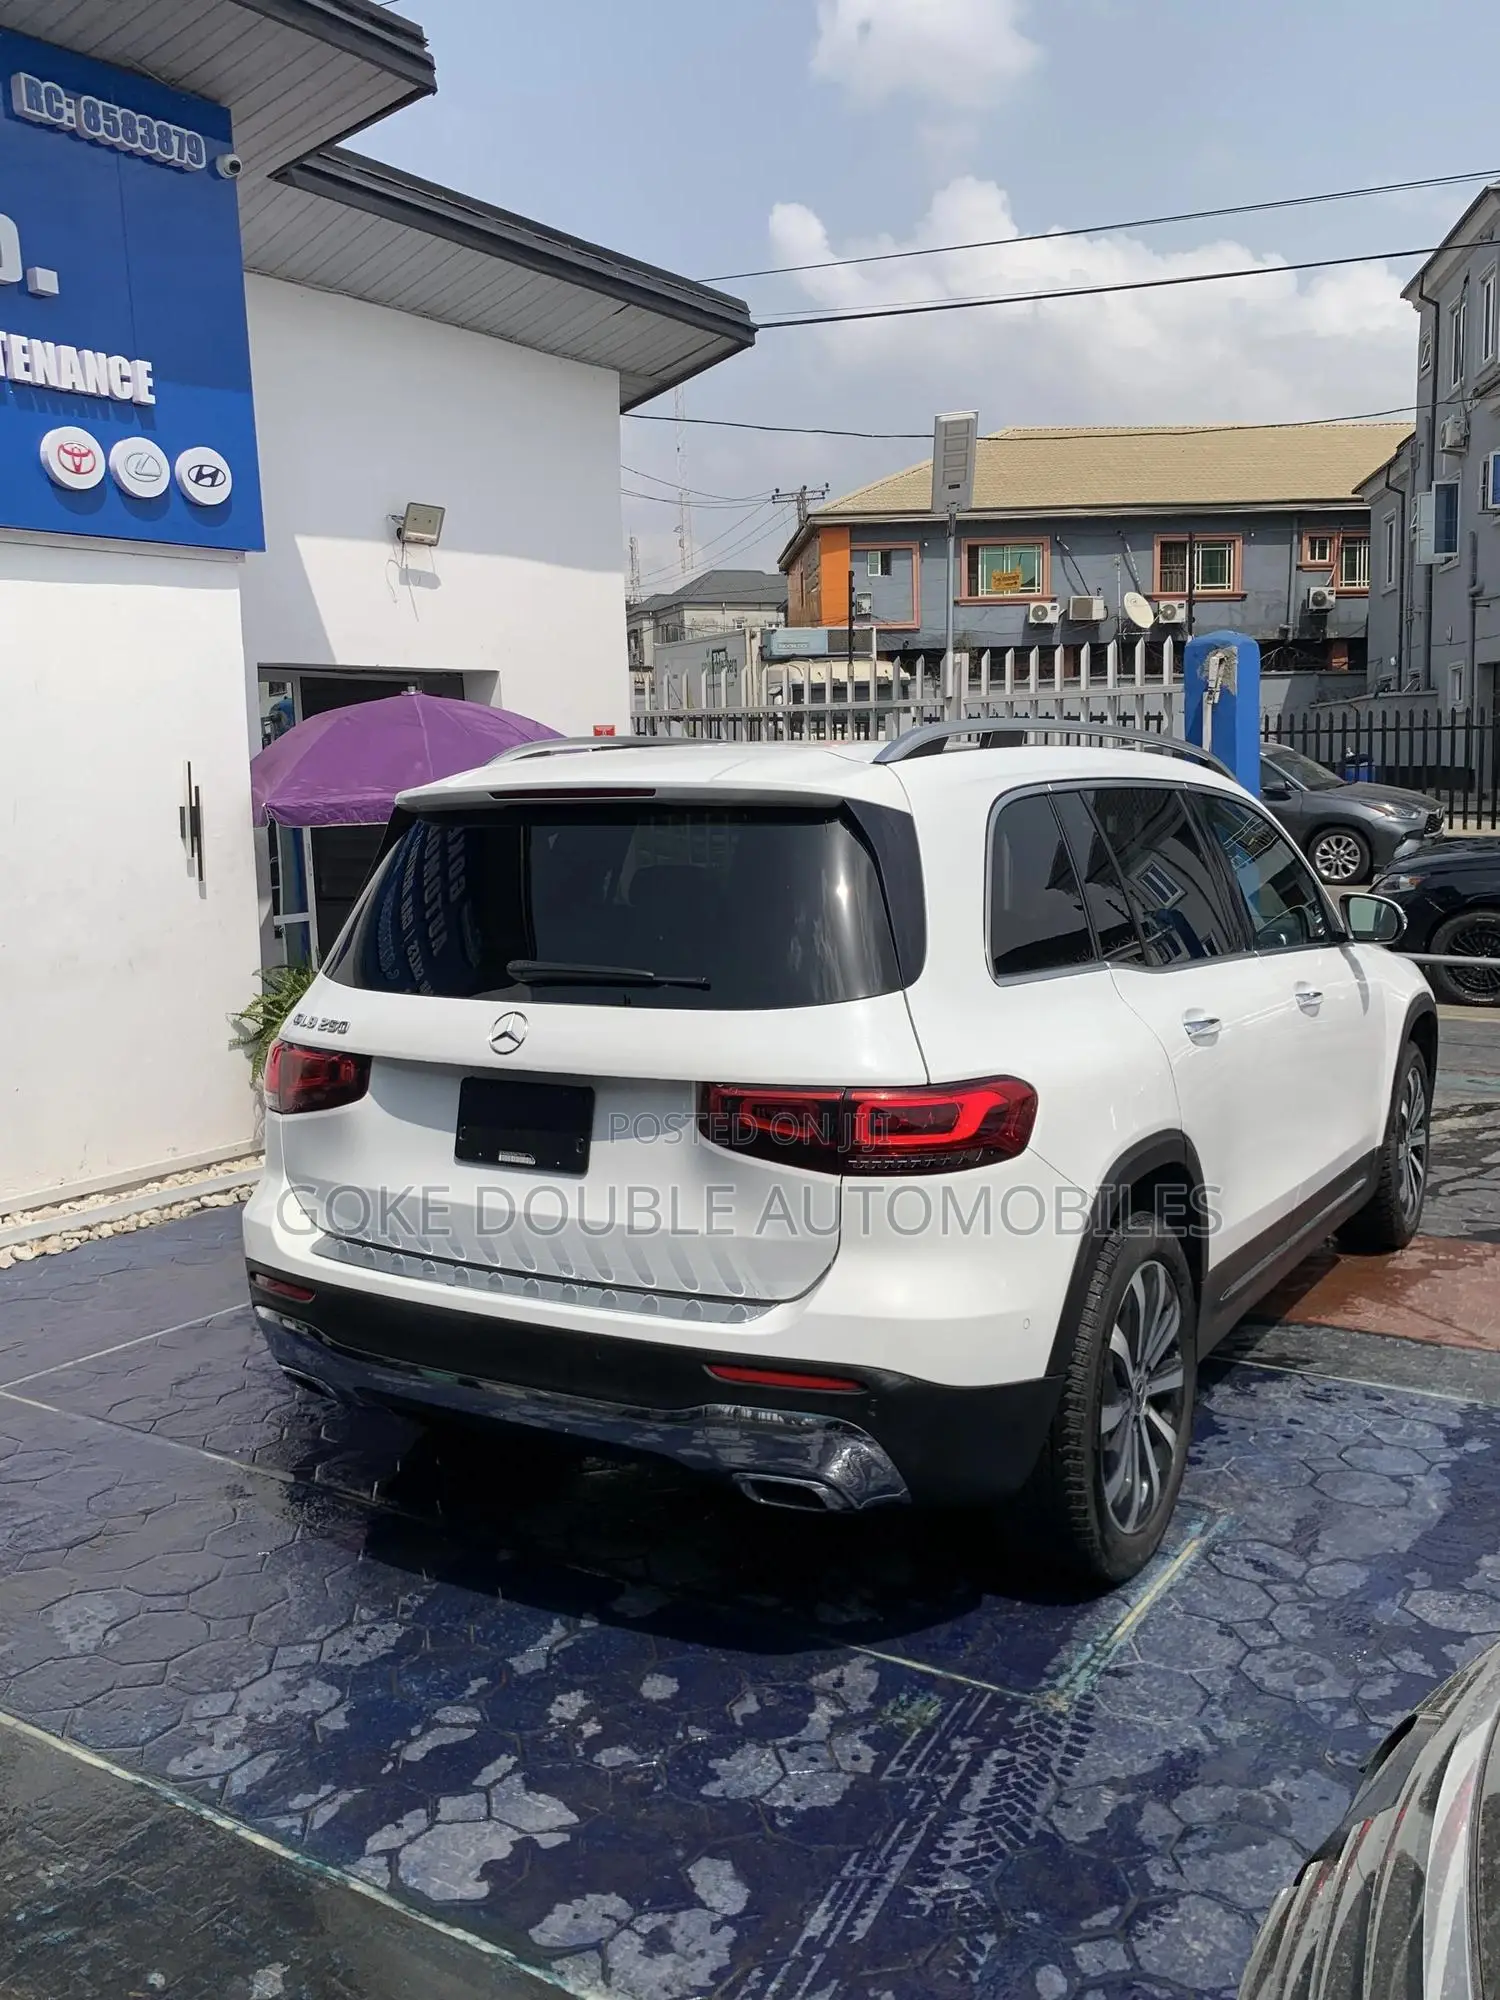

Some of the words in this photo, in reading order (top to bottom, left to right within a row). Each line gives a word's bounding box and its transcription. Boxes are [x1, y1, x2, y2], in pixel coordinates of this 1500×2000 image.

[11, 71, 76, 131] RC:
[77, 95, 207, 172] 8583879
[318, 1018, 350, 1035] 250
